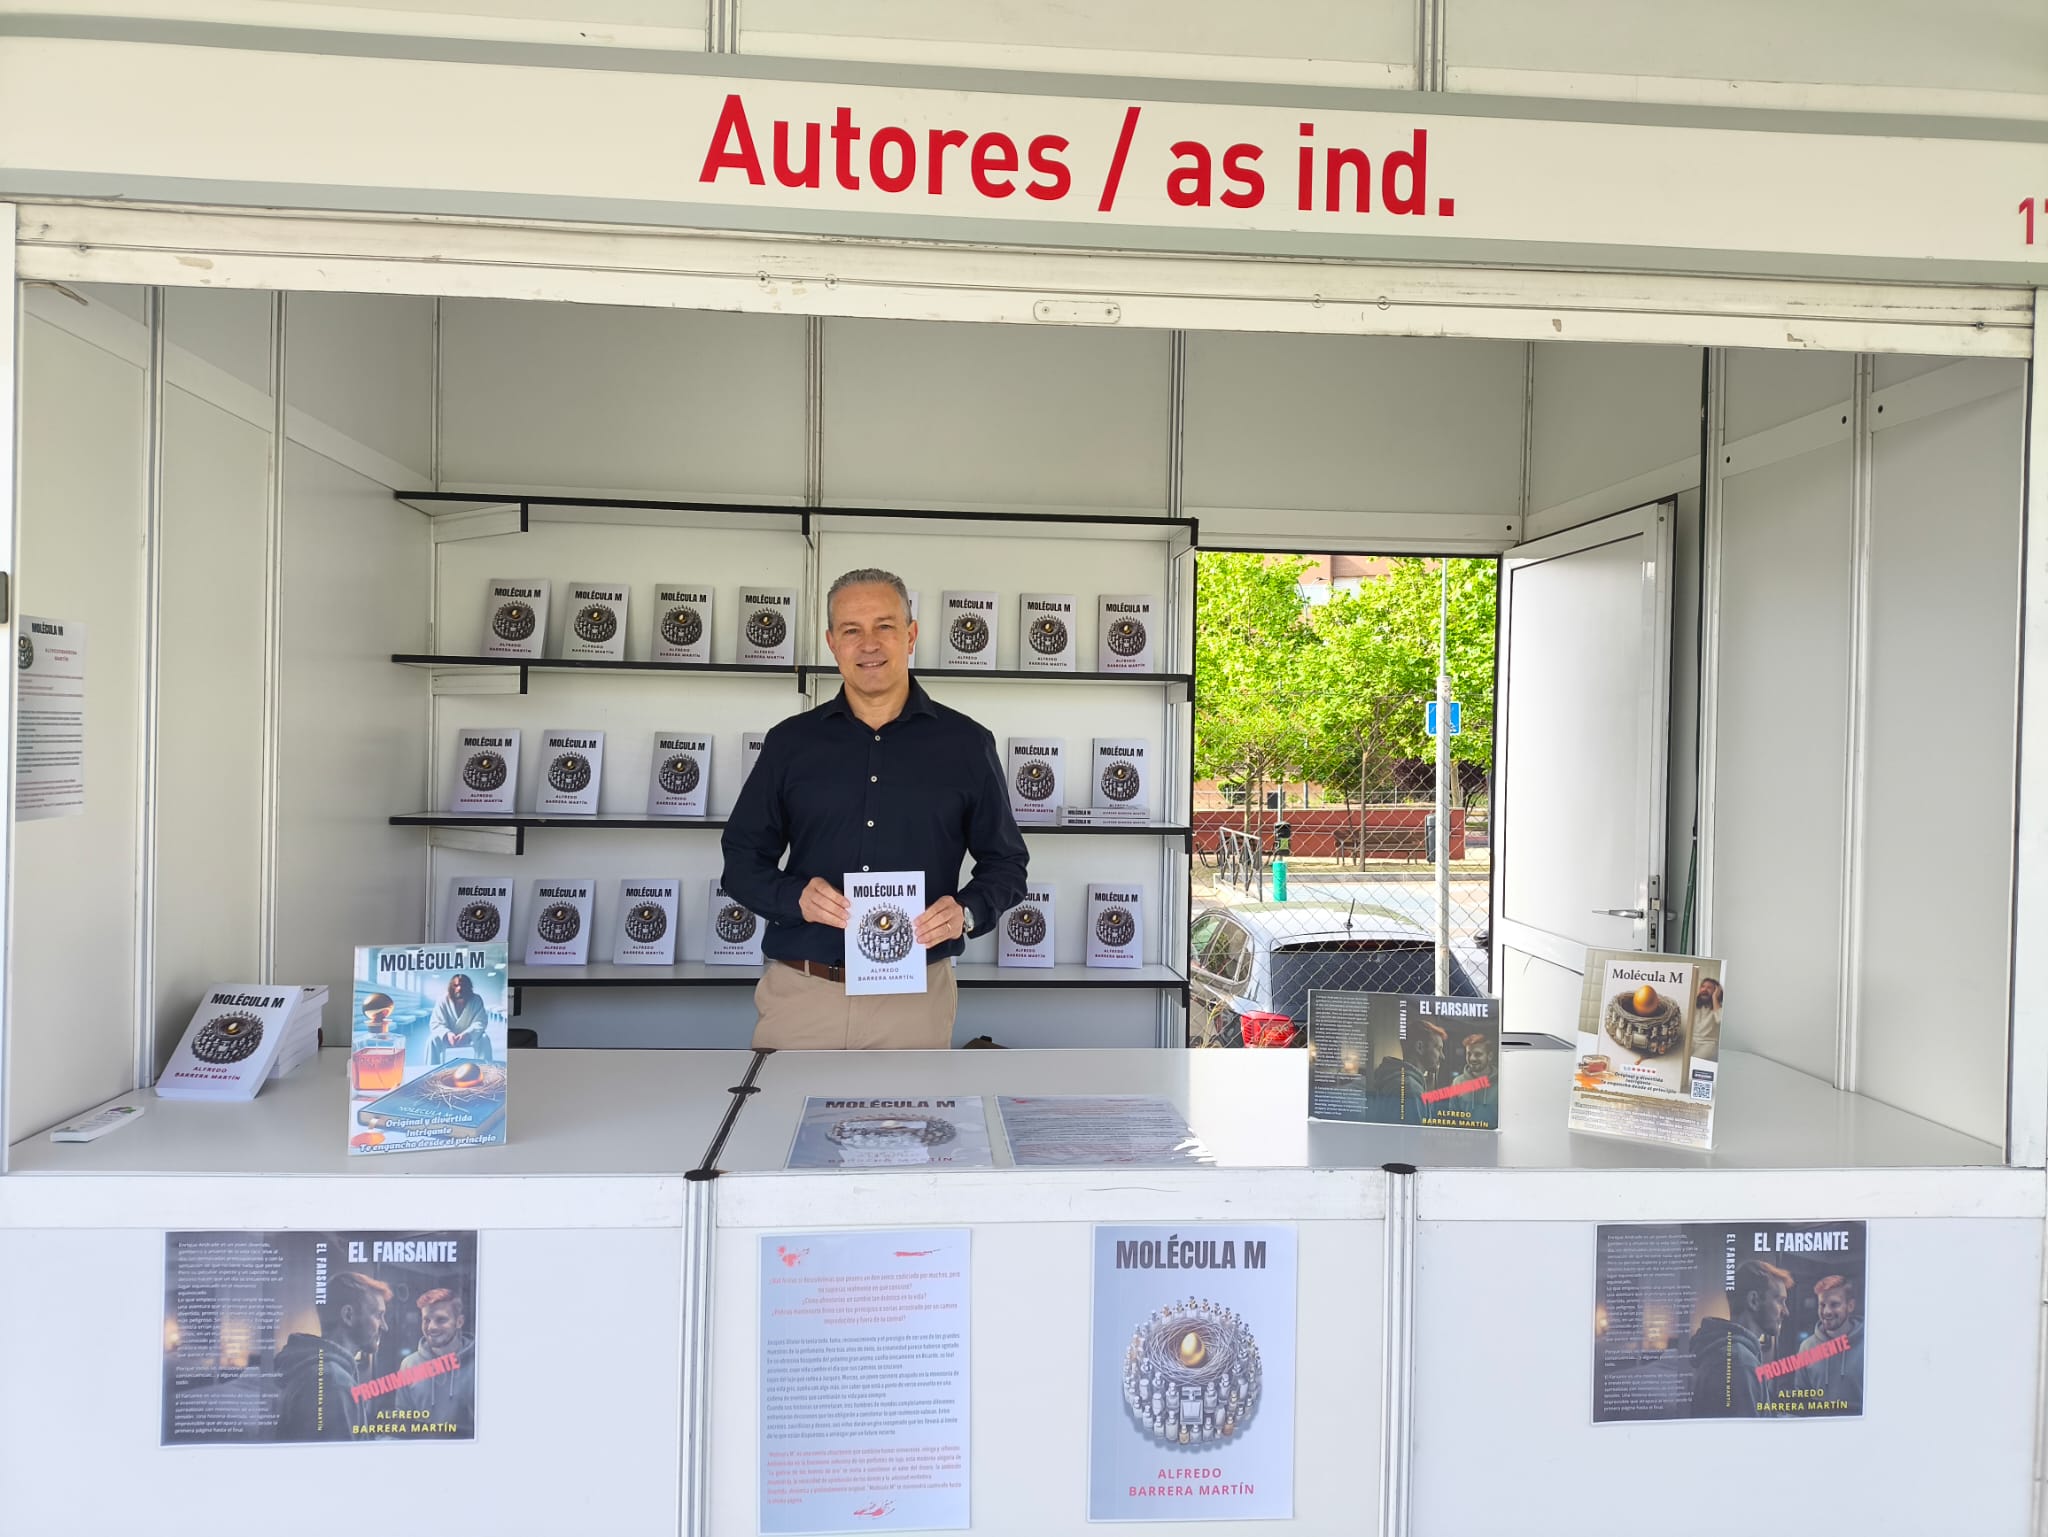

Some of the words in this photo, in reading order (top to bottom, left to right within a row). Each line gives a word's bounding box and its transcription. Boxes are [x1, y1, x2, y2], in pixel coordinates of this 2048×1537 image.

[699, 94, 1071, 200] Autores
[1098, 107, 1141, 211] /
[1167, 141, 1264, 207] as
[1298, 122, 1454, 216] ind.
[495, 587, 532, 597] MOLÉCULA
[534, 590, 541, 598] M
[575, 590, 612, 600] MOLÉCULA
[615, 593, 622, 601] M
[661, 592, 698, 602] MOLÉCULA
[700, 595, 707, 603] M
[745, 594, 781, 605] MOLÉCULA
[783, 597, 790, 605] M
[949, 598, 985, 610] MOLÉCULA
[986, 601, 992, 610] M
[1027, 600, 1063, 612] MOLÉCULA
[1064, 604, 1071, 612] M
[1106, 601, 1141, 612] MOLÉCULA
[1143, 604, 1149, 613] M
[464, 736, 502, 747] MOLÉCULA
[504, 738, 512, 747] M
[549, 737, 587, 748] MOLÉCULA
[589, 740, 596, 748] M
[660, 739, 696, 750] MOLÉCULA
[698, 742, 705, 750] M
[1015, 745, 1050, 756] MOLÉCULA
[1051, 747, 1059, 756] M
[1100, 746, 1135, 757] MOLÉCULA
[1136, 749, 1144, 757] M
[458, 885, 496, 896] MOLÉCULA
[498, 888, 506, 896] M
[539, 887, 577, 898] MOLÉCULA
[579, 889, 586, 898] M
[626, 887, 662, 897] MOLÉCULA
[664, 889, 672, 897] M
[853, 883, 904, 897] MOLÉCULA
[907, 885, 916, 897] M
[1042, 893, 1049, 902] M
[1095, 891, 1129, 902] MOLÉCULA
[1131, 894, 1138, 902] M
[380, 950, 464, 972] MOLÉCULA
[470, 952, 485, 968] M
[1612, 968, 1666, 983] Molécula
[1669, 972, 1684, 984] M
[211, 993, 270, 1008] MOLÉCULA
[271, 998, 285, 1008] M
[1420, 1000, 1432, 1015] EL
[1435, 1001, 1489, 1018] FARSANTE
[825, 1099, 929, 1109] MOLÉCULA
[936, 1100, 956, 1108] M
[1437, 1110, 1471, 1118] ALFREDO
[385, 1118, 424, 1127] Original
[425, 1119, 430, 1127] y
[431, 1114, 473, 1124] divertida
[1422, 1118, 1456, 1126] BARRERA
[1459, 1119, 1489, 1128] MARTÍN
[372, 1141, 417, 1152] engancha
[418, 1138, 444, 1148] desde
[445, 1137, 454, 1146] el
[454, 1134, 496, 1145] principio
[1726, 1233, 1735, 1244] EL
[1754, 1232, 1771, 1252] EL
[1775, 1231, 1849, 1252] FARSANTE
[316, 1243, 327, 1254] EL
[348, 1242, 368, 1263] EL
[373, 1241, 457, 1263] FARSANTE
[1116, 1234, 1236, 1269] MOLÉCULA
[1244, 1241, 1266, 1269] M
[1726, 1248, 1735, 1291] FARSANTE
[315, 1258, 327, 1305] FARSANTE
[1755, 1334, 1852, 1384] PROXIMAMENTE
[351, 1352, 460, 1404] PROXIMAMENTE
[1778, 1389, 1824, 1398] ALFREDO
[1757, 1402, 1804, 1411] BARRERA
[1808, 1399, 1848, 1410] MARTÍN
[377, 1410, 430, 1419] ALFREDO
[352, 1424, 406, 1434] BARRERA
[411, 1422, 457, 1432] MARTÍN
[1158, 1468, 1222, 1479] ALFREDO
[1128, 1484, 1194, 1497] BARRERA
[1199, 1482, 1255, 1496] MARTÍN
